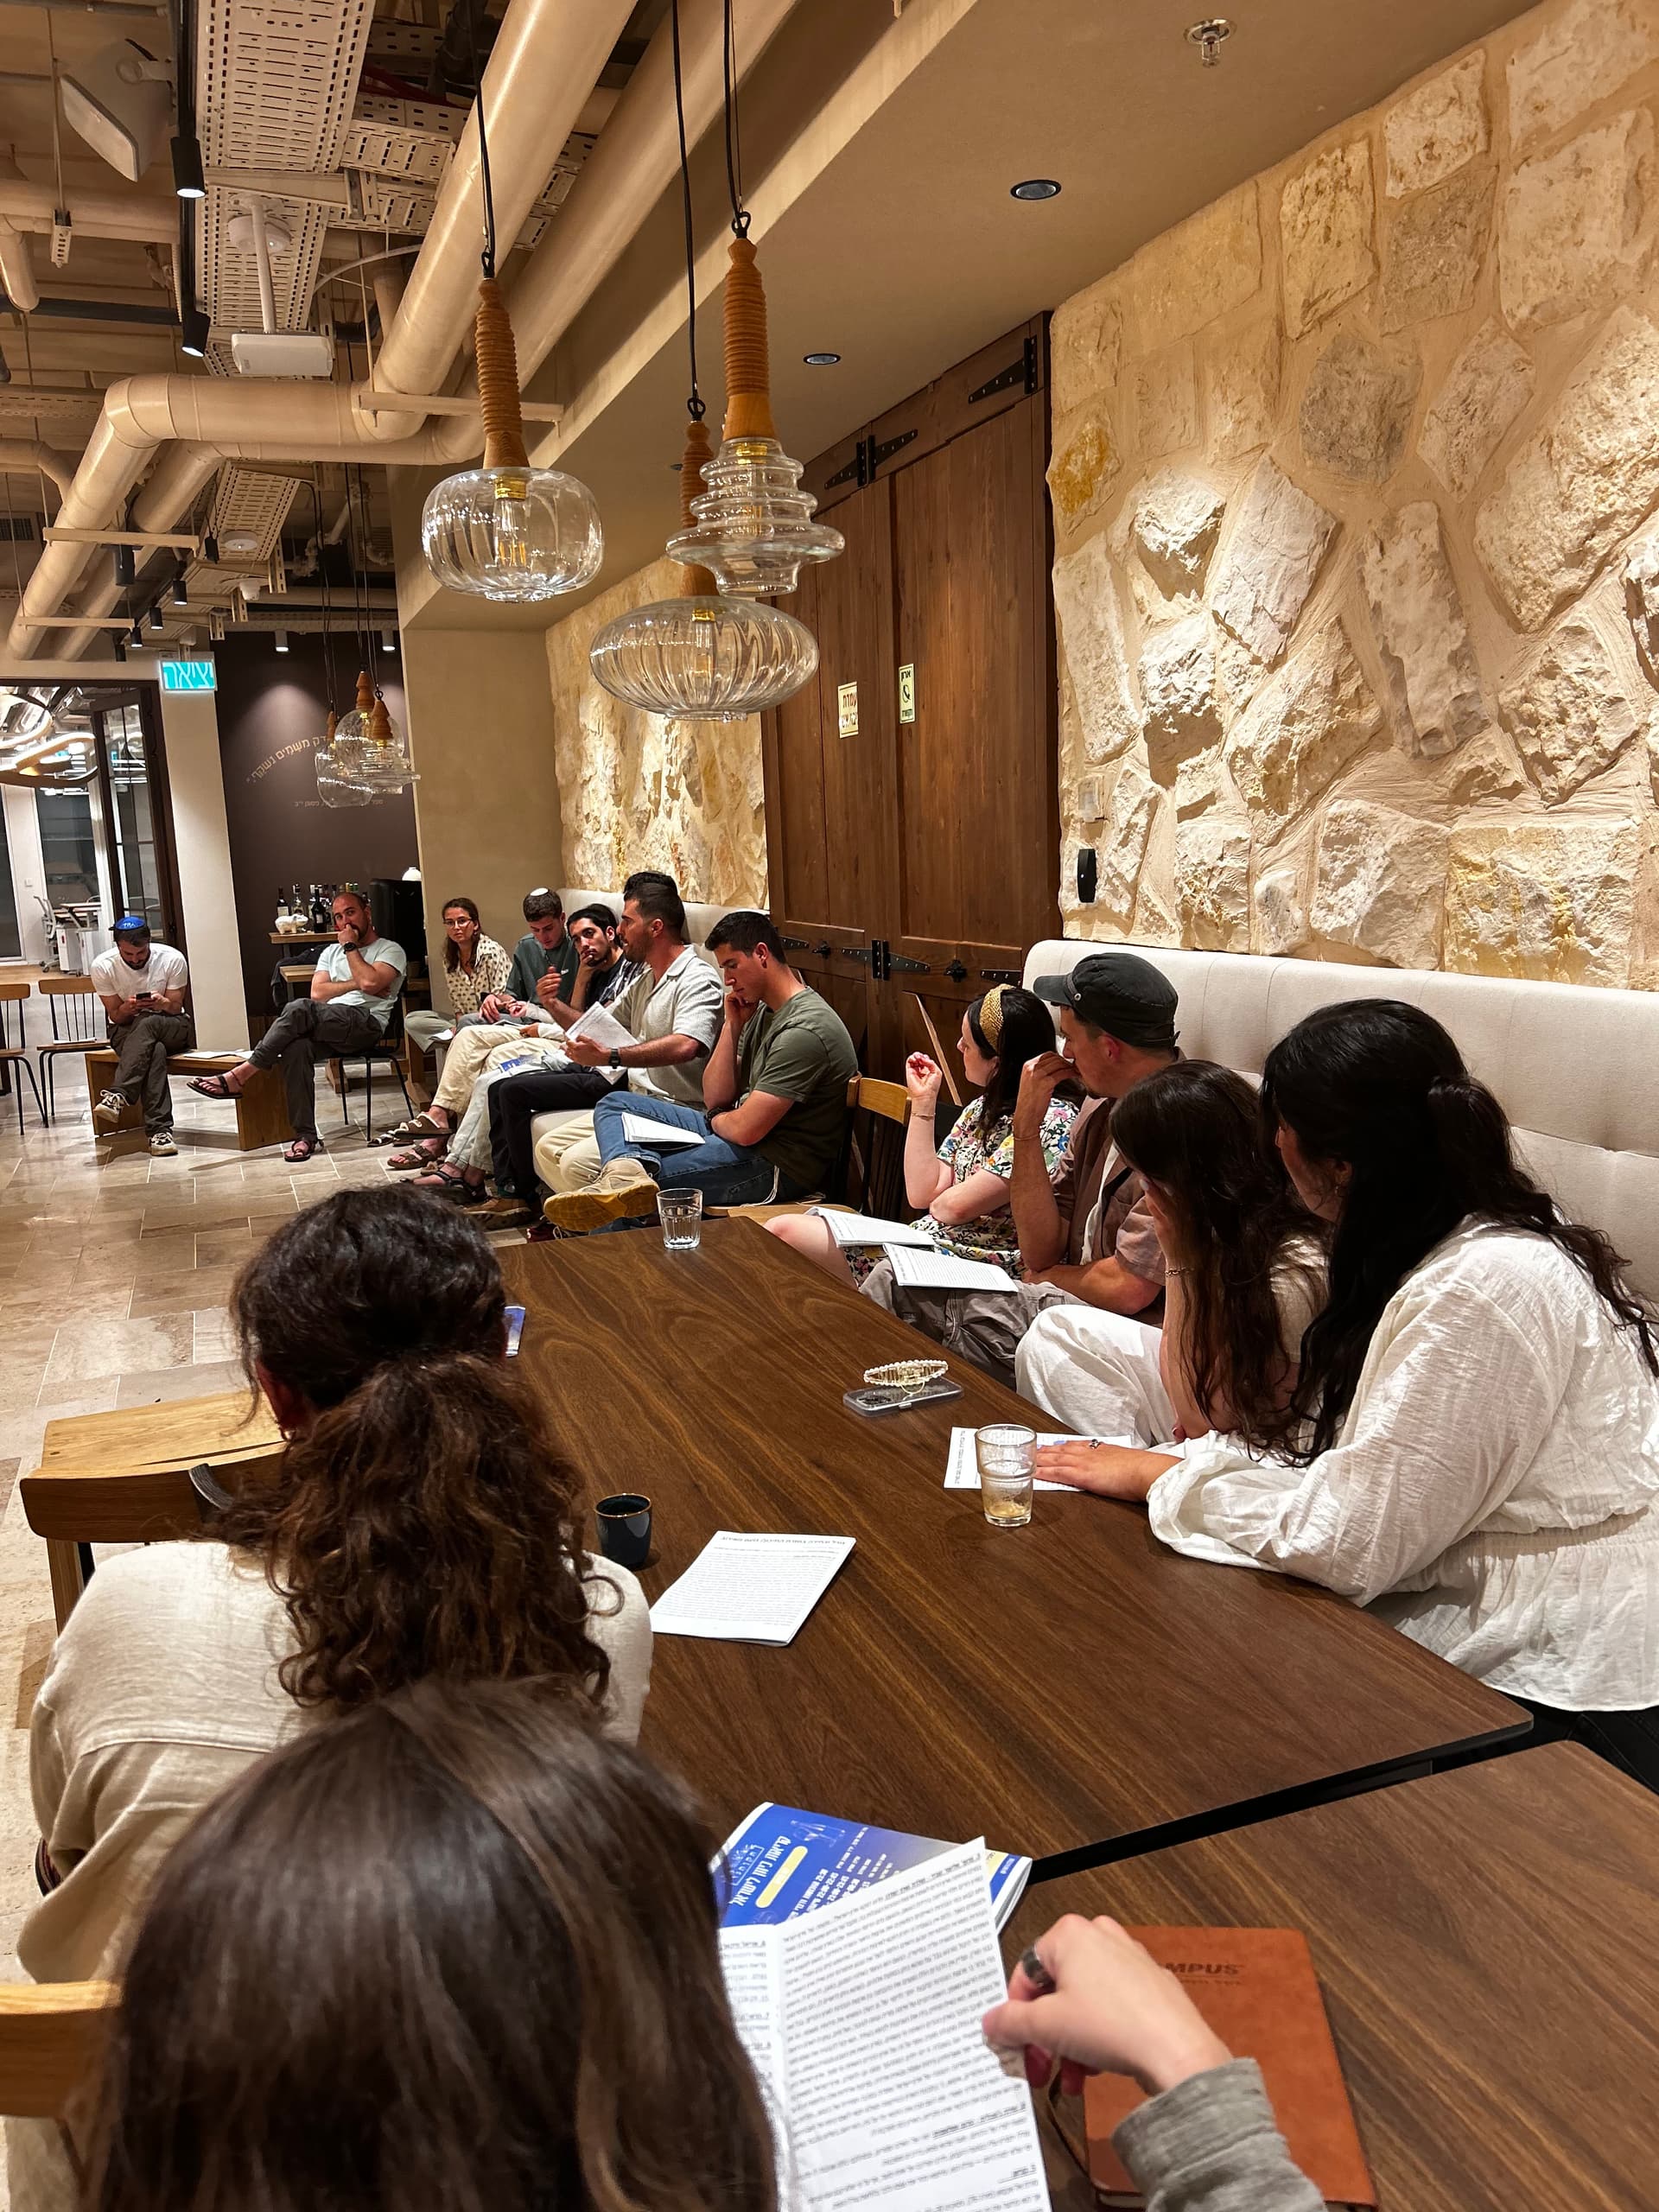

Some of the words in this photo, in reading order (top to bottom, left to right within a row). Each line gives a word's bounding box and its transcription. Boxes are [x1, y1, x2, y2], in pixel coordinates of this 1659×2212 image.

[162, 662, 215, 689] יציאה
[728, 1876, 761, 1907] לישראל
[1165, 1962, 1239, 1975] MPUS
